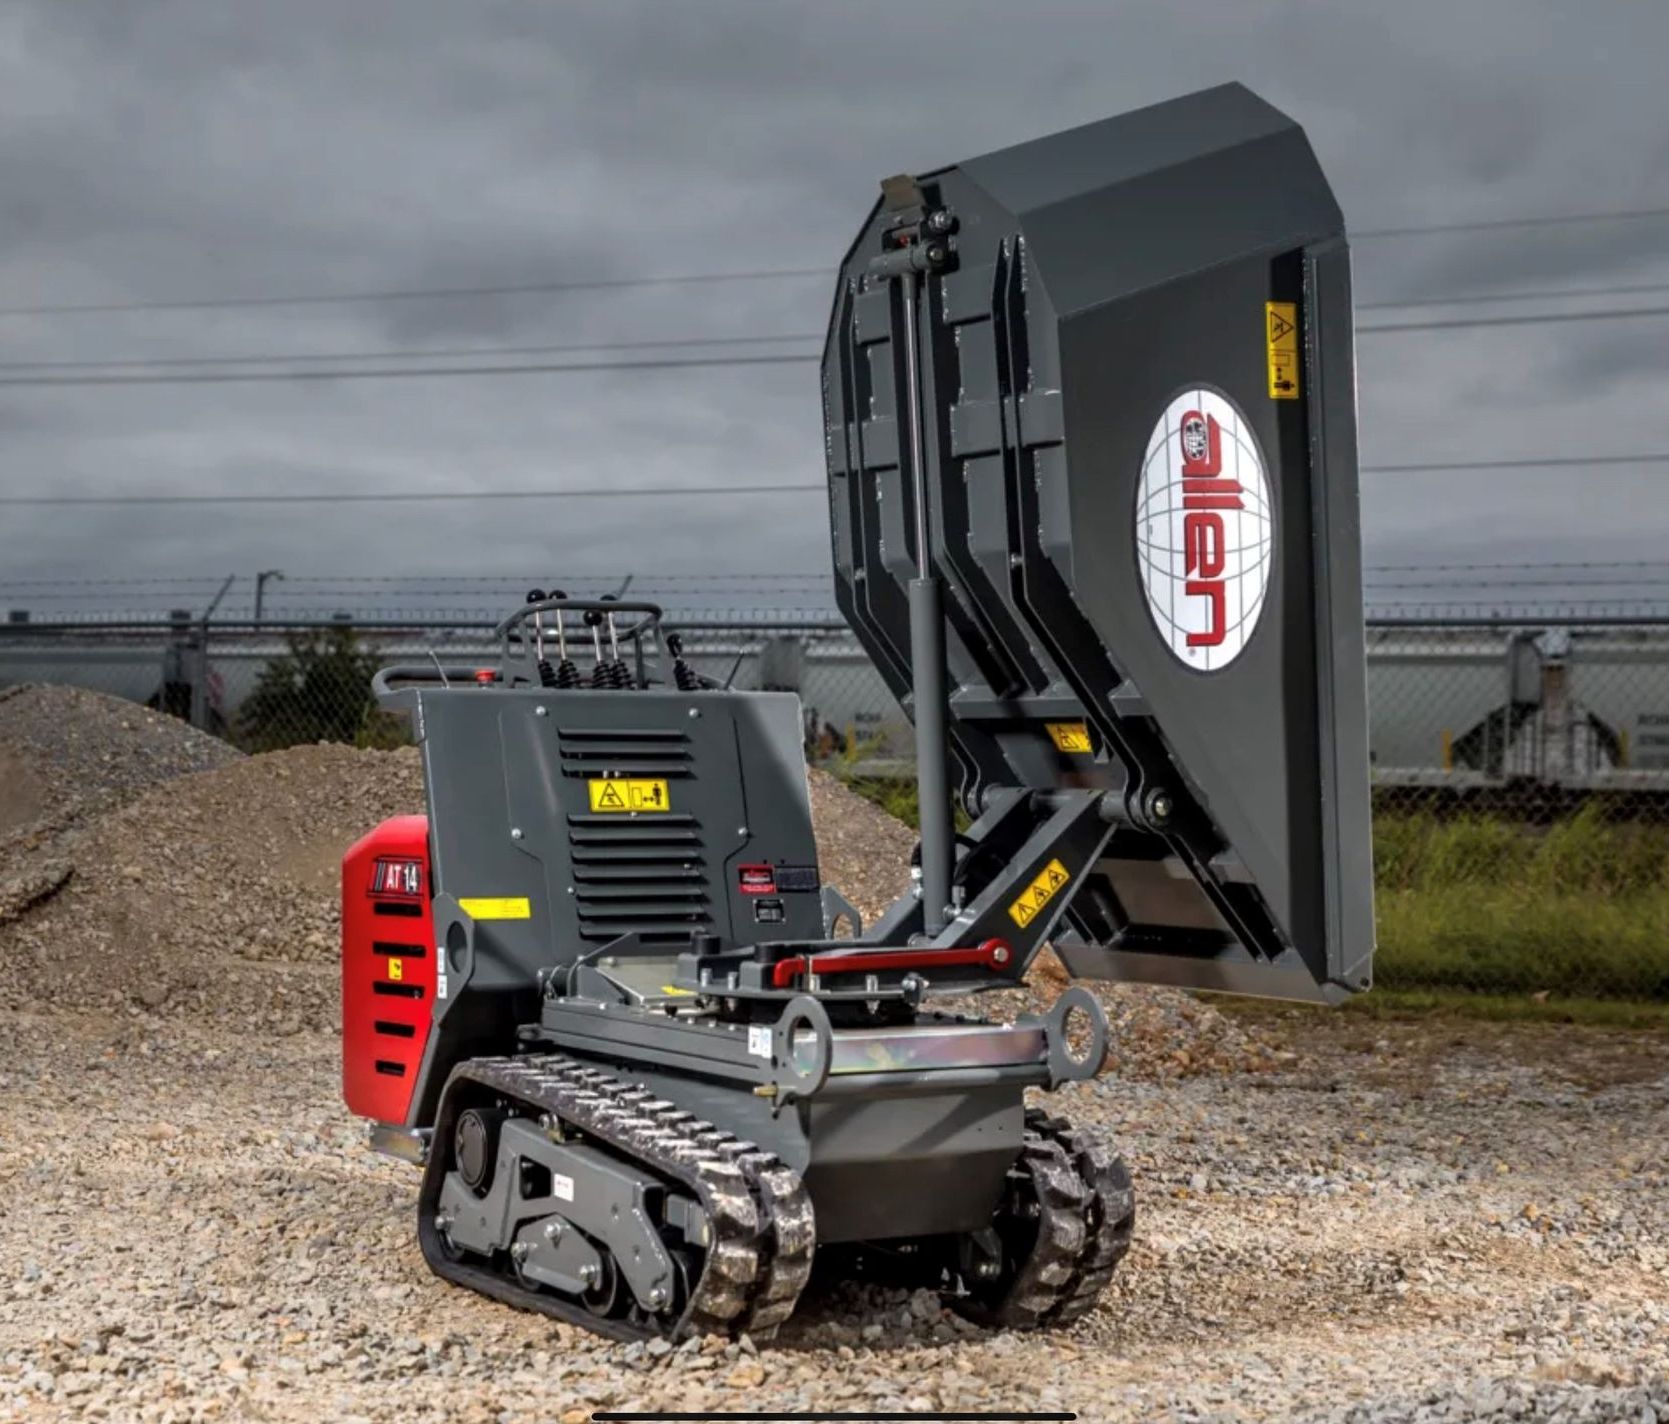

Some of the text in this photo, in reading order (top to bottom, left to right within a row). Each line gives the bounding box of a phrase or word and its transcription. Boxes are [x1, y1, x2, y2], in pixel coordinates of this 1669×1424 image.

[1180, 410, 1245, 647] allen
[386, 864, 418, 893] AT 14
